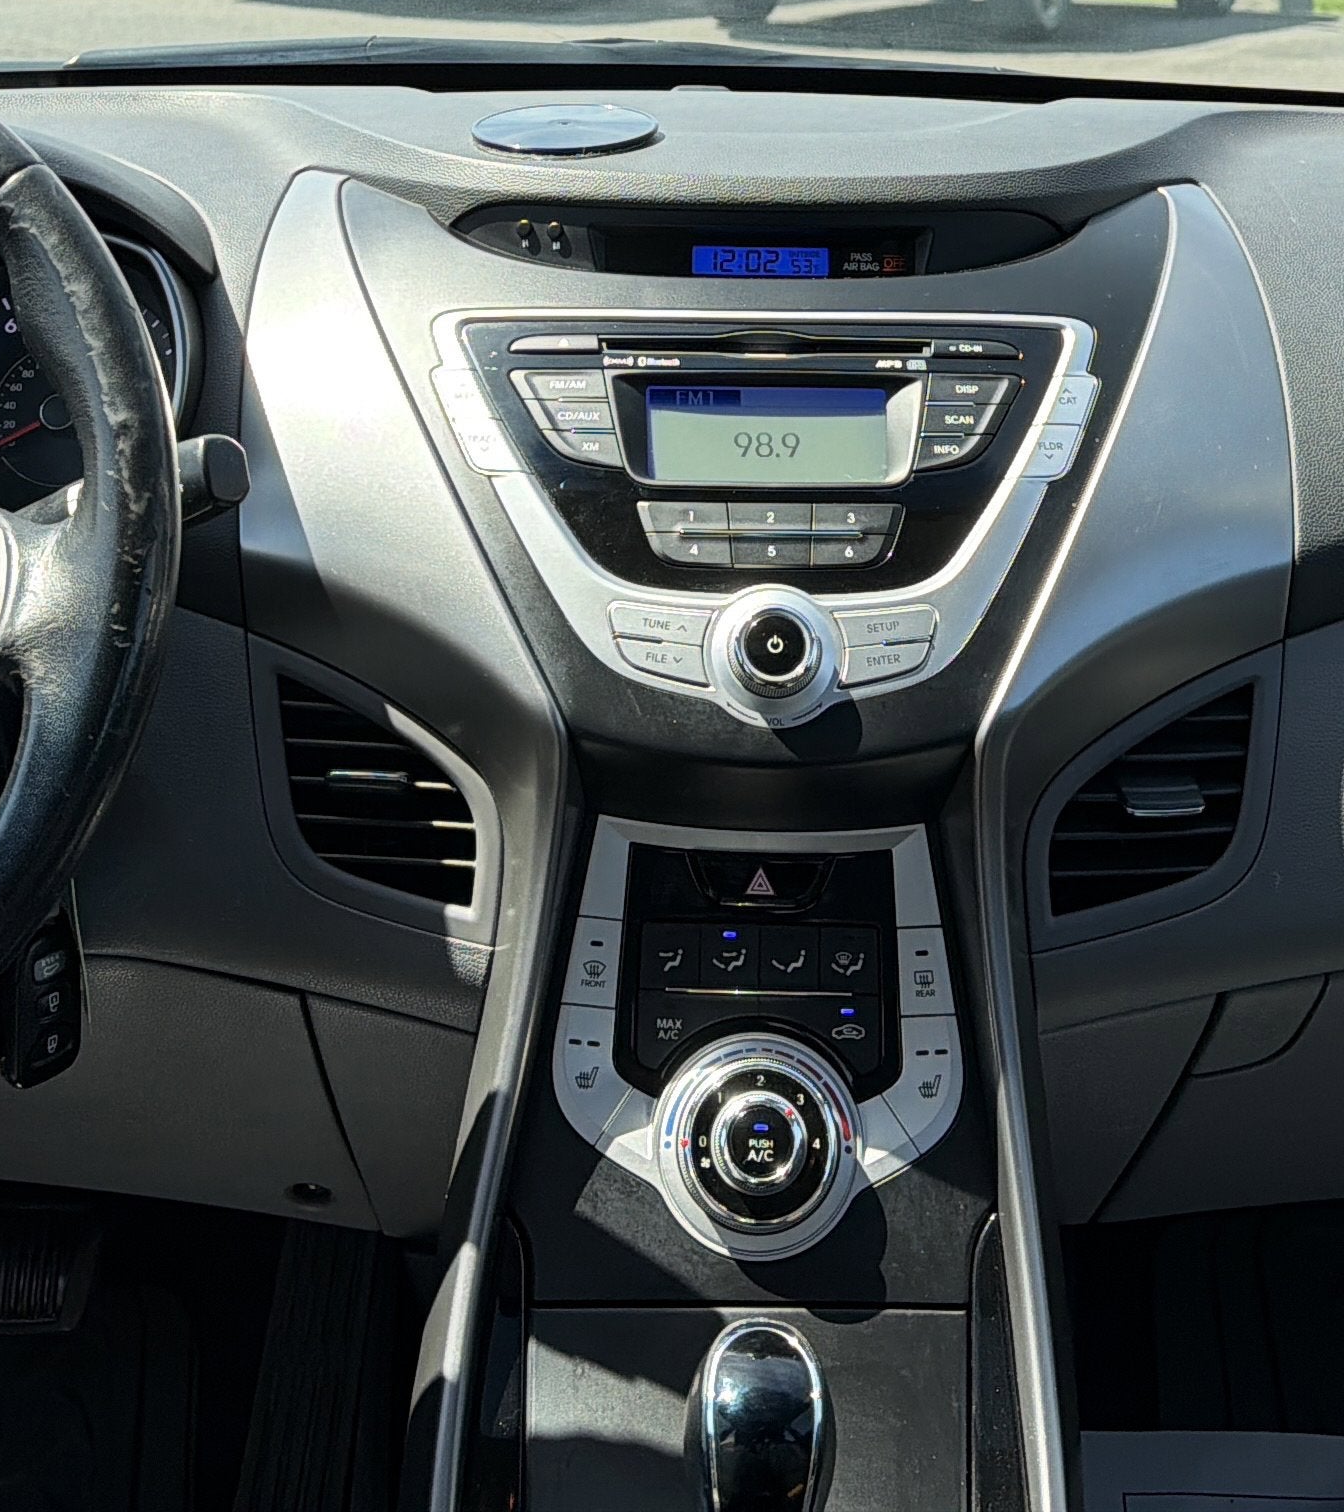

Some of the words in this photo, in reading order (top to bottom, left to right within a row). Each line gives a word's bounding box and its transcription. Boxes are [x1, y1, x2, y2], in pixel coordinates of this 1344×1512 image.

[712, 248, 780, 274] 12:02
[850, 252, 873, 262] PASS
[843, 262, 859, 272] AIR
[860, 262, 880, 272] BAG
[883, 258, 905, 269] OFF
[9, 383, 23, 392] 60
[549, 379, 587, 390] FM/AM
[955, 384, 979, 394] DISP
[3, 401, 17, 409] 40
[1058, 395, 1077, 405] CAT
[557, 410, 600, 421] CD/AUX
[944, 415, 975, 425] SCAN
[3, 420, 16, 429] 20
[581, 441, 600, 452] XM
[734, 431, 801, 459] 98.9
[933, 444, 959, 455] INFO
[1038, 441, 1063, 452] FLDR
[688, 511, 695, 522] 1
[766, 511, 775, 523] 2
[846, 512, 856, 523] 3
[689, 545, 698, 556] 4
[767, 545, 777, 557] 5
[844, 545, 854, 557] 6
[642, 617, 671, 631] TUNE
[866, 620, 900, 633] SETUP
[645, 651, 668, 664] FILE
[866, 653, 901, 667] ENTER
[580, 978, 606, 989] FRONT
[915, 988, 936, 998] REAR
[657, 1018, 683, 1029] MAX
[658, 1029, 680, 1040] A/C
[756, 1075, 765, 1086] 2
[717, 1093, 723, 1105] 1
[796, 1093, 804, 1105] 3
[699, 1136, 707, 1148] 0
[748, 1139, 774, 1149] PUSH
[812, 1138, 821, 1150] 4
[746, 1149, 775, 1163] A/C
